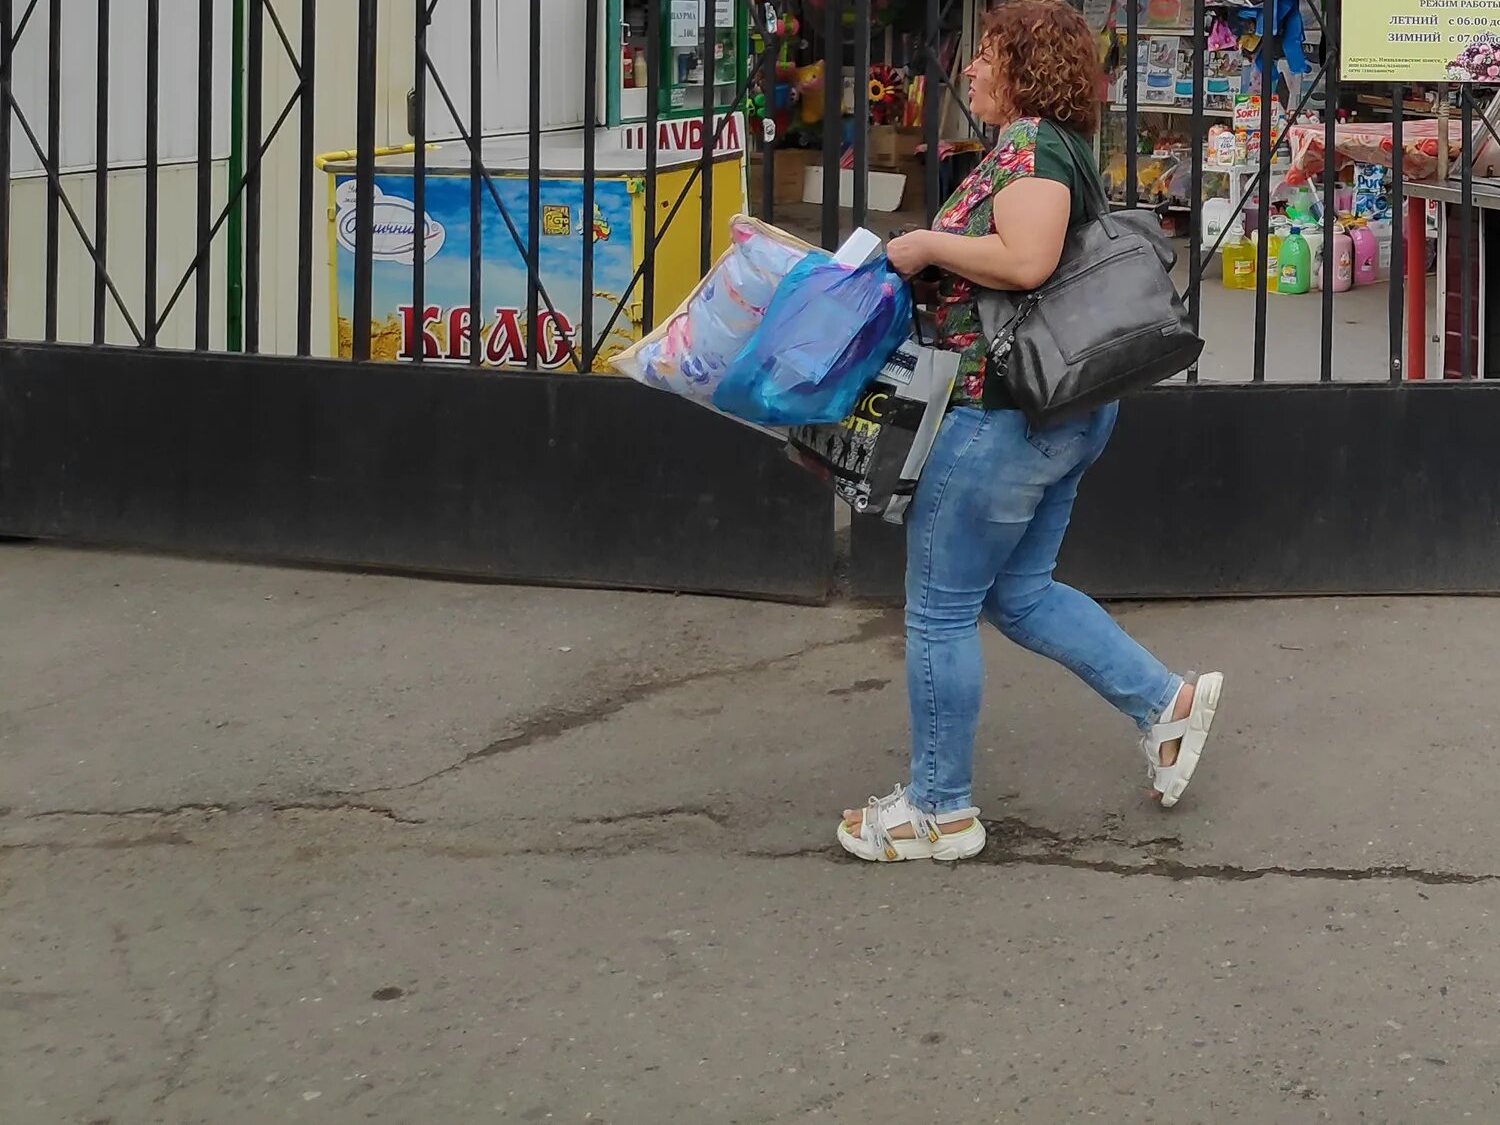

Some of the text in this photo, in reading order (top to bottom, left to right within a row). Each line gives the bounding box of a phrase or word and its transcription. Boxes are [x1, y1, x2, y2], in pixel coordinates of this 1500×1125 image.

[1420, 0, 1458, 9] РЕЖИМ
[1389, 15, 1438, 26] ЛЕТНИЙ
[1456, 17, 1488, 27] 06.00
[1388, 32, 1441, 43] ЗИМНИЙ
